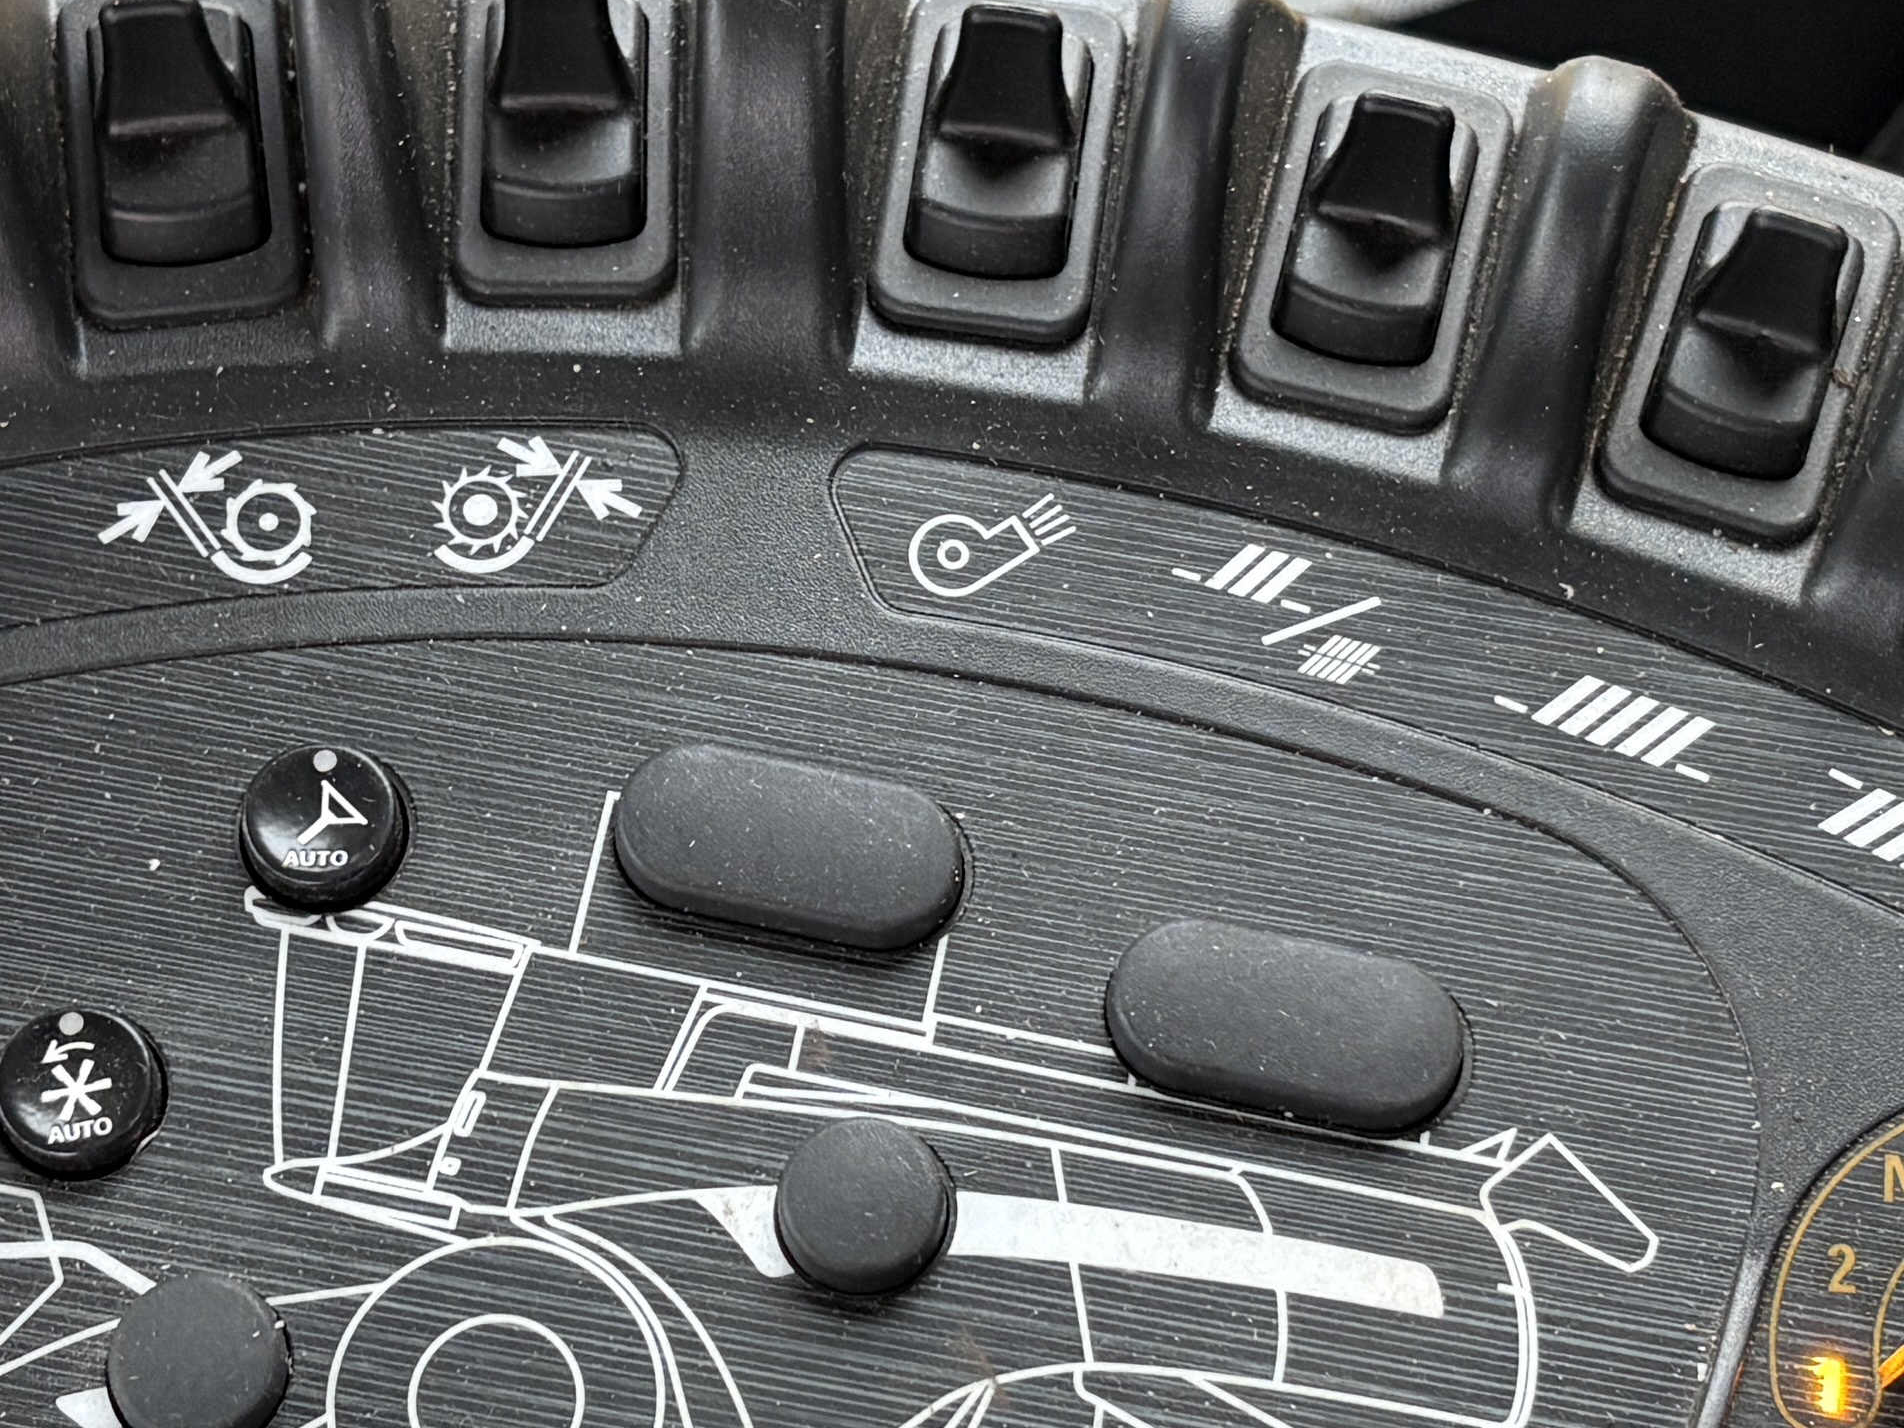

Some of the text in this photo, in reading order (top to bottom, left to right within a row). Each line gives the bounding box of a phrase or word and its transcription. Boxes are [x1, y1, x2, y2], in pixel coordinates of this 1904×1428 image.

[282, 850, 348, 868] AUTO
[48, 1117, 113, 1144] AUTO
[1827, 1244, 1857, 1294] 2
[1809, 1357, 1845, 1415] 1
